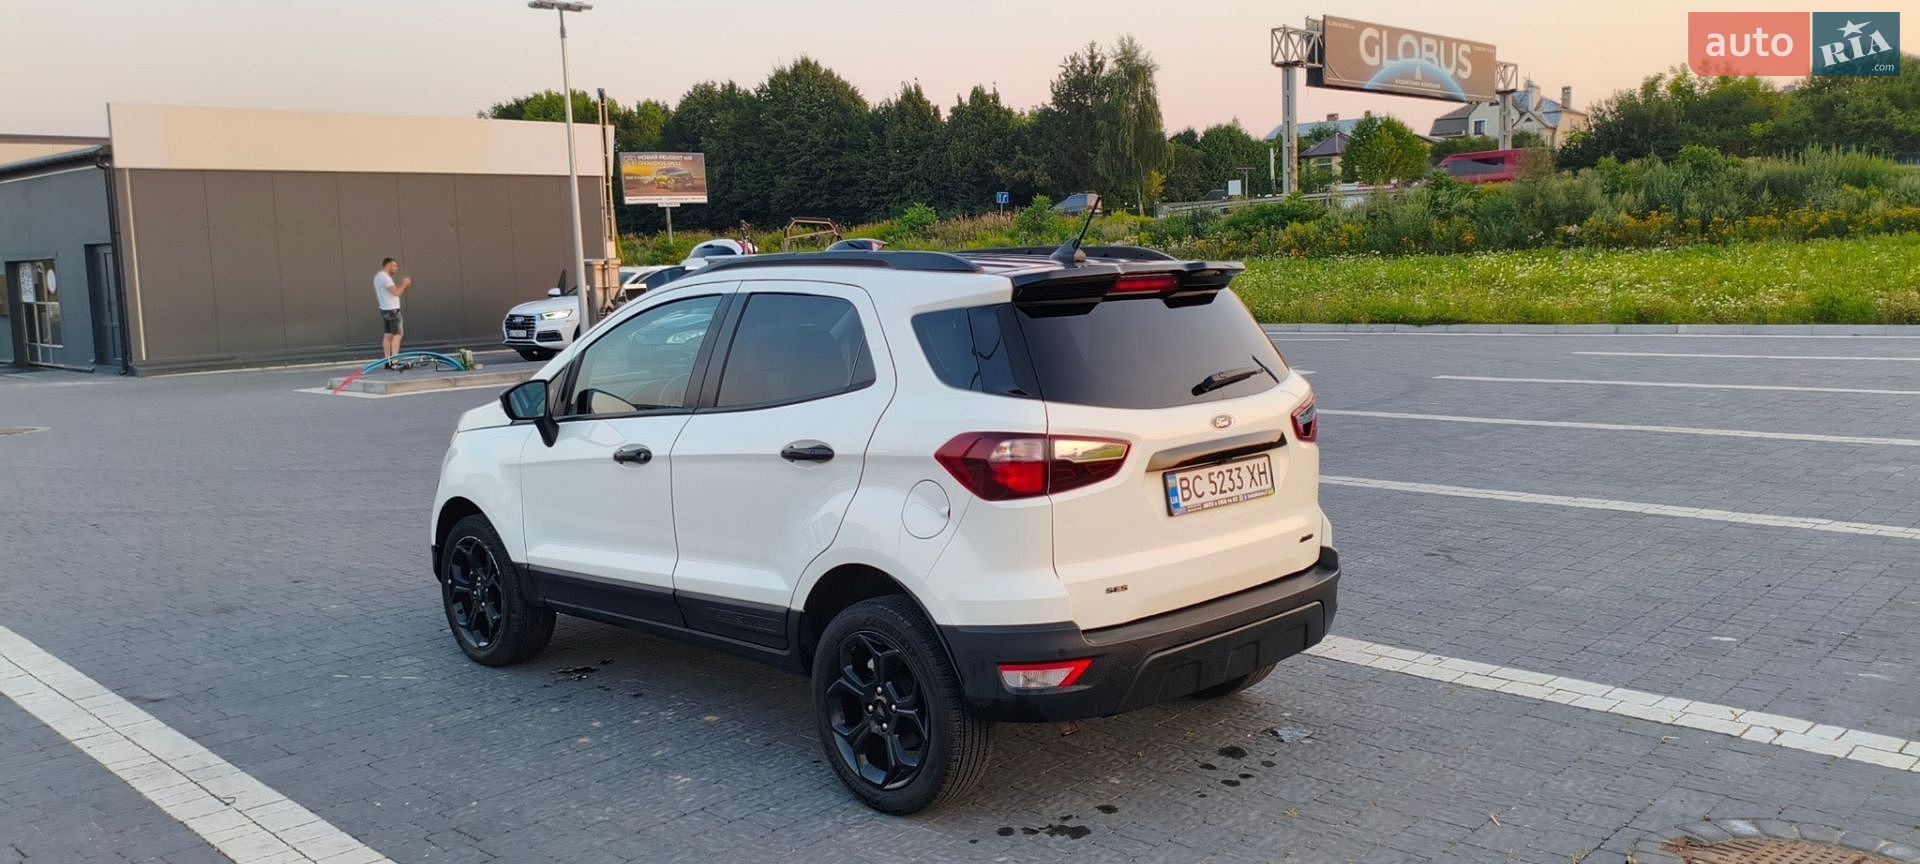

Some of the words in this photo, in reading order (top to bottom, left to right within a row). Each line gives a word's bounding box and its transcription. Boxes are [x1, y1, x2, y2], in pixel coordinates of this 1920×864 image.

[1359, 27, 1473, 80] GLOBUS
[1180, 475, 1205, 502] BC
[1208, 466, 1244, 496] 5233
[1246, 461, 1269, 489] XH
